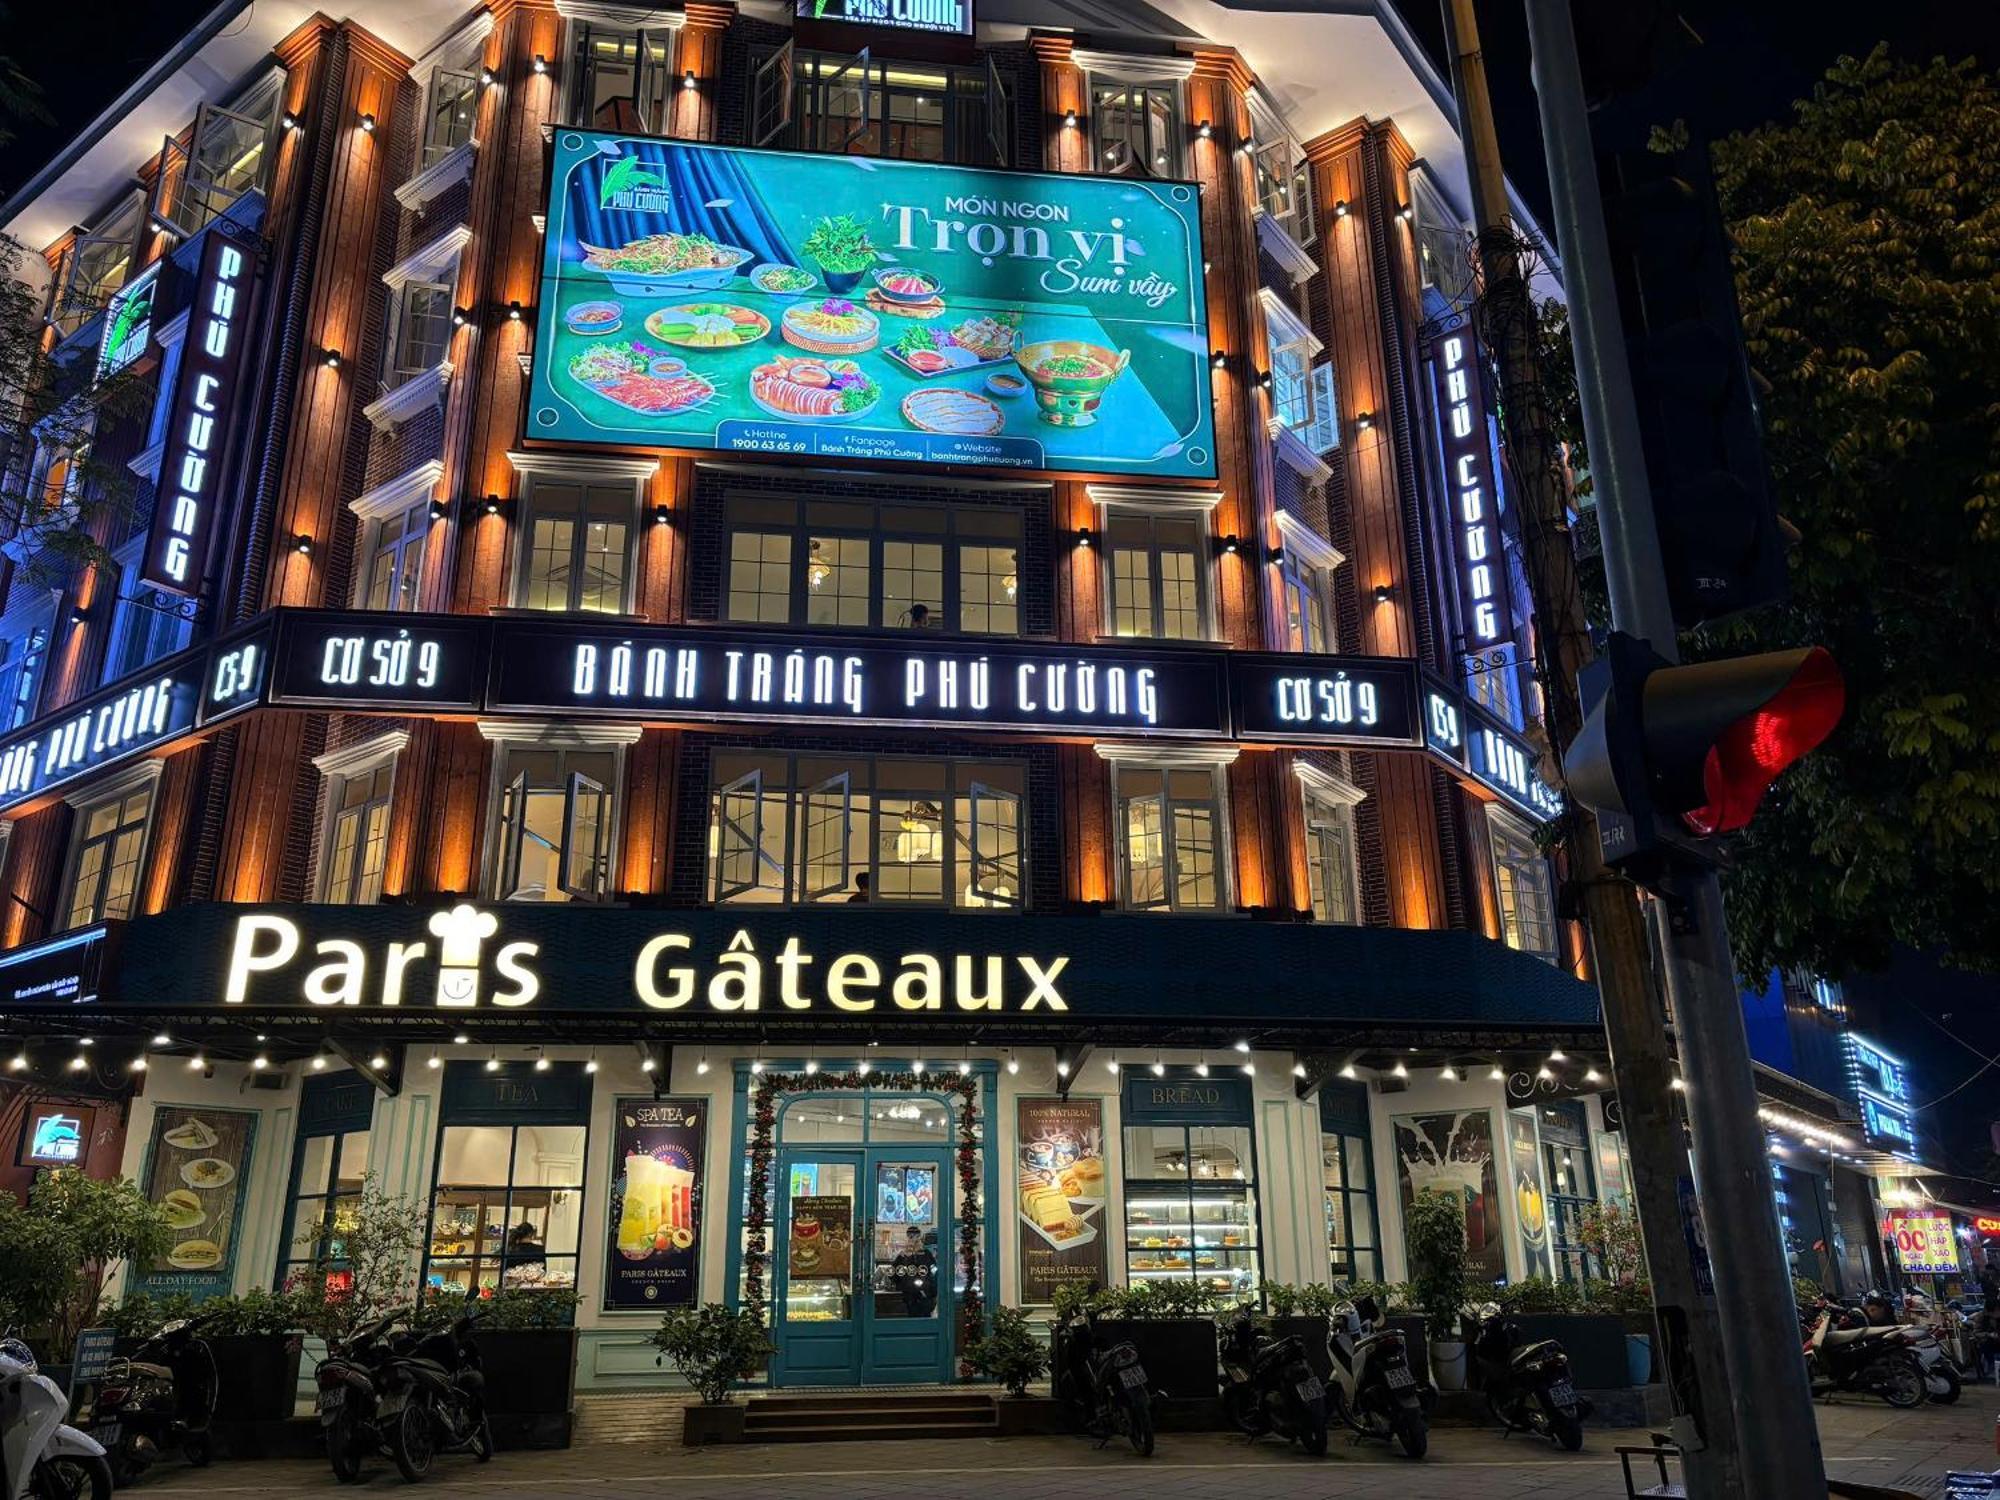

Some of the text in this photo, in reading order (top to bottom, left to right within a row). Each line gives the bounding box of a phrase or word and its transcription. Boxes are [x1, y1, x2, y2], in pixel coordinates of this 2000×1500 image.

[945, 195, 1070, 222] MÓN NGON
[881, 203, 1132, 276] Trọn vị
[1040, 259, 1178, 307] Sum vầy
[164, 245, 242, 583] PHÚ CƯỜNG
[732, 438, 806, 452] 1900 63 65 69
[752, 429, 787, 440] Hotline
[851, 435, 896, 447] Fanpage
[961, 443, 1002, 453] Website
[1443, 336, 1497, 640] PHÚ CƯỜNG
[320, 629, 441, 688] CƠ SỞ 9
[571, 639, 1158, 725] BÁNH TRÁNG PHÚ CƯỜNG
[1277, 670, 1379, 726] CƠ SỞ 9
[45, 709, 93, 776] PHÚ
[93, 678, 172, 753] CƯỜNG
[224, 904, 1073, 1013] Paris Gâteaux
[637, 1108, 684, 1122] SPA TEA
[1151, 1089, 1220, 1104] BREAD
[1897, 1219, 1926, 1252] ỐC
[1030, 1264, 1098, 1275] PARIS GÂTEAUX
